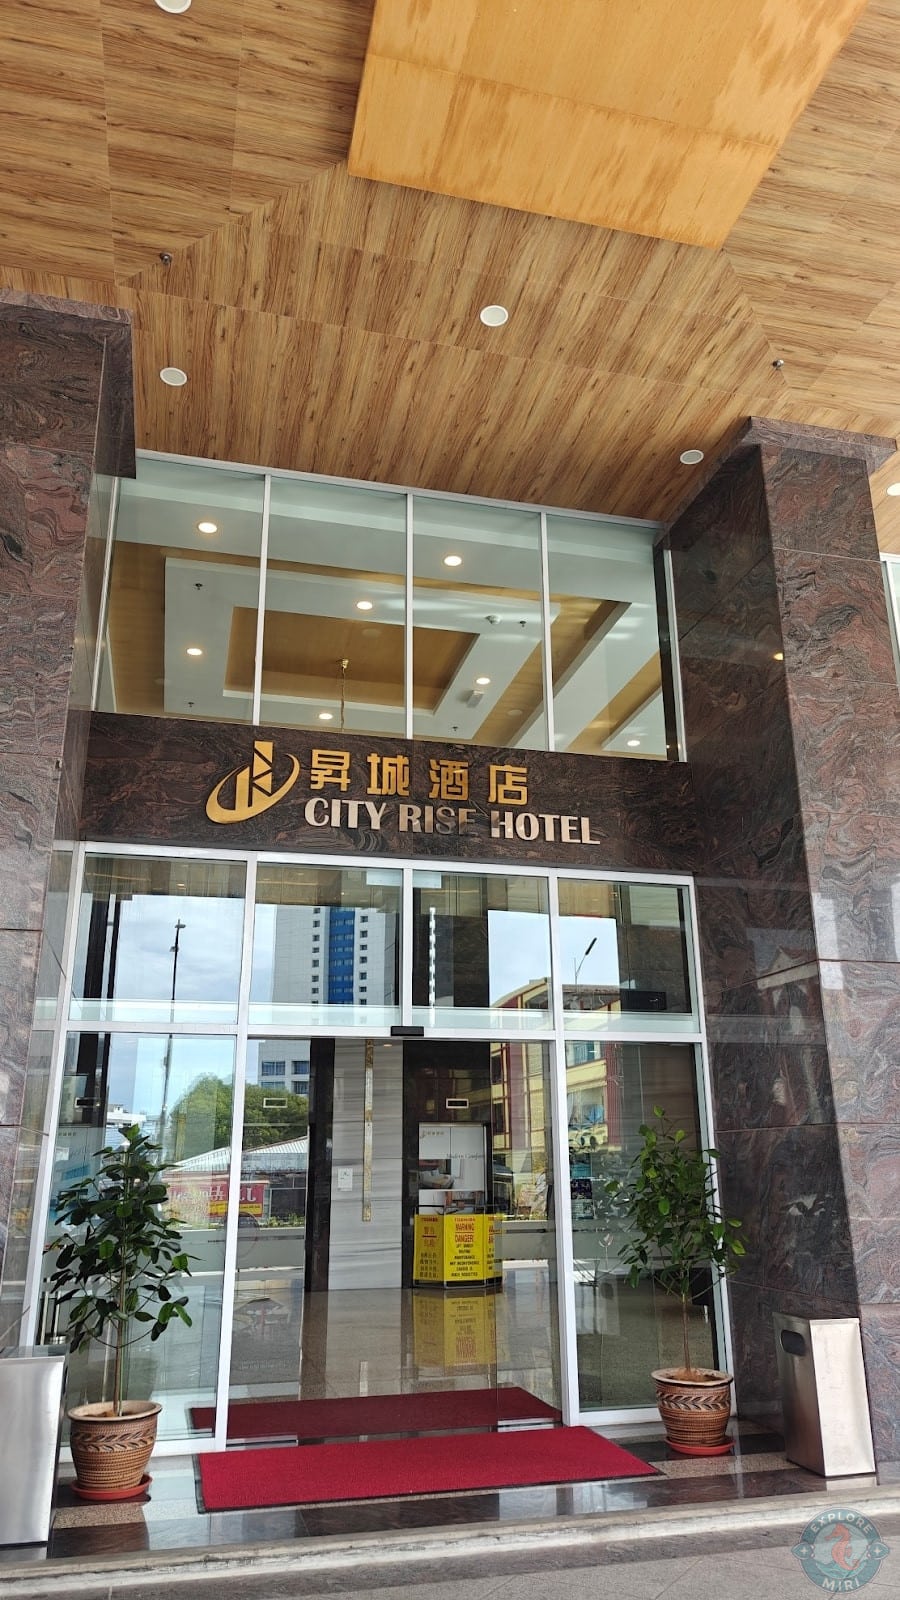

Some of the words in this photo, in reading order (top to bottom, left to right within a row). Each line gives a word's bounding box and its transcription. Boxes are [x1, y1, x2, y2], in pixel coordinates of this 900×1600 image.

[310, 748, 529, 806] 昇城酒店
[304, 797, 388, 831] CITY
[400, 803, 478, 836] RISE
[490, 810, 601, 845] HOTEL
[454, 1234, 474, 1243] DANGER
